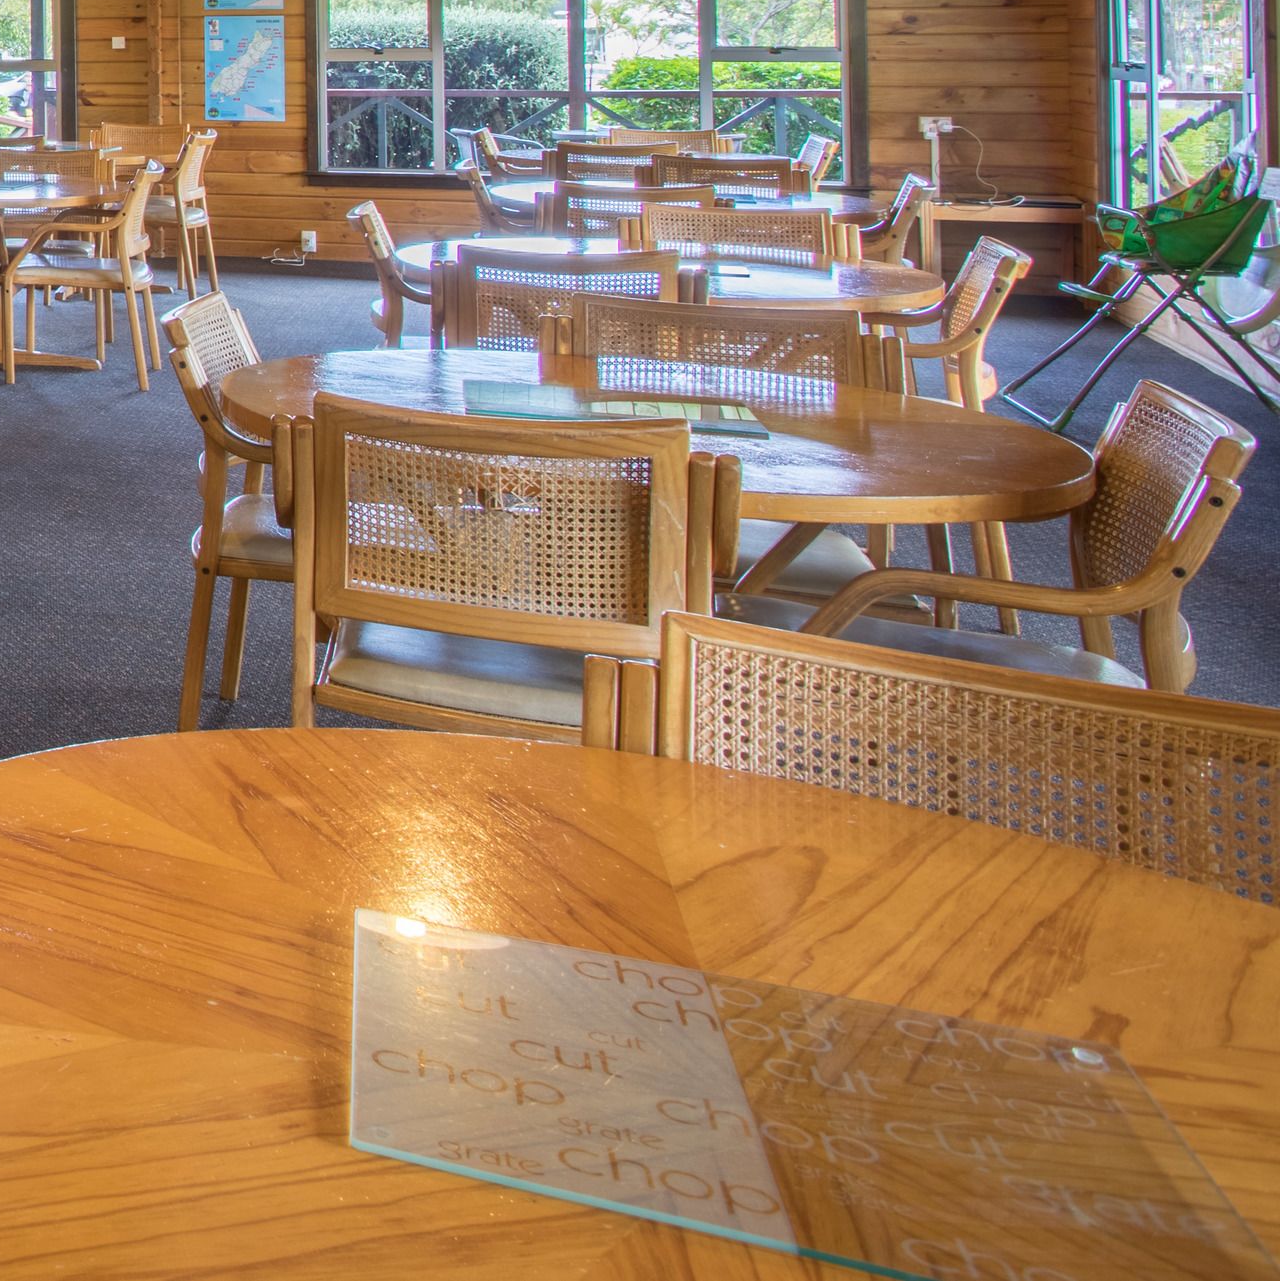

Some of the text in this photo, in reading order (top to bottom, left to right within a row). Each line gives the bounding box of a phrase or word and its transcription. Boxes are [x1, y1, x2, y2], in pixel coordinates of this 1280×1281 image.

[573, 959, 762, 1008] chop
[588, 1031, 645, 1051] cut
[632, 1000, 832, 1053] chop
[895, 1018, 1110, 1073] chop
[371, 1049, 566, 1106] chop
[510, 1039, 623, 1079] cut
[763, 1058, 888, 1100] cut
[882, 1045, 981, 1071] chop
[930, 1081, 1096, 1128] chop
[557, 1116, 665, 1150] grate
[656, 1098, 879, 1162] chop
[884, 1121, 1022, 1170] cut
[438, 1140, 545, 1176] grate
[558, 1147, 781, 1215] chop
